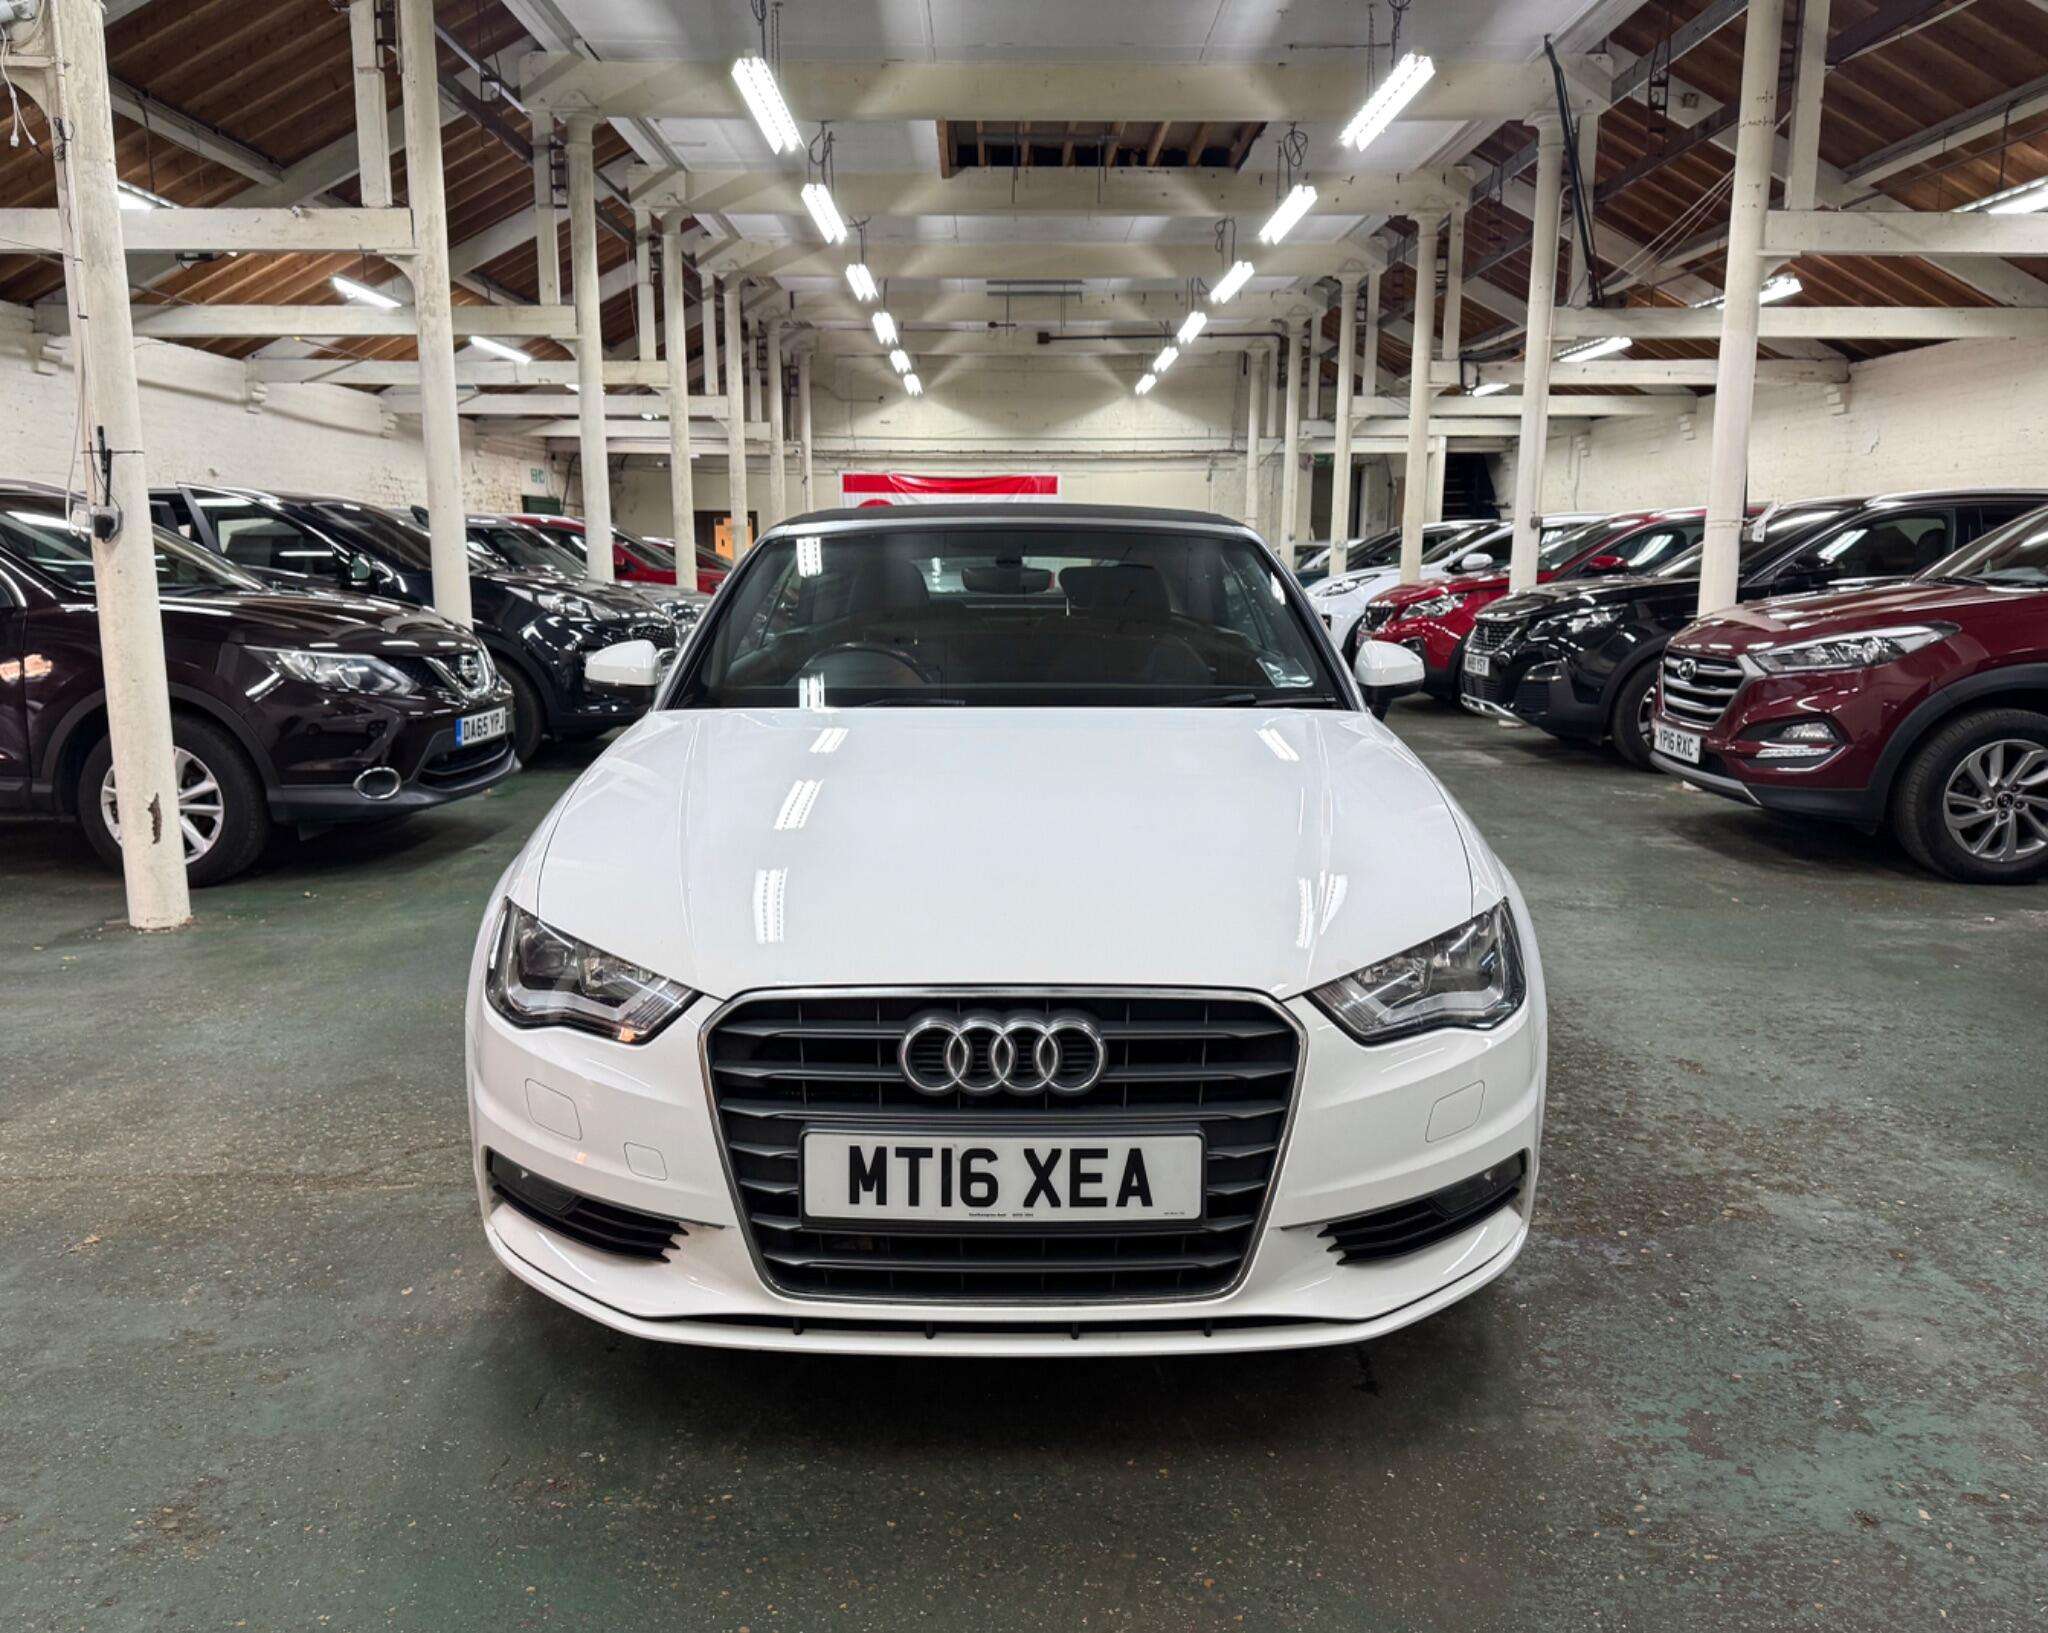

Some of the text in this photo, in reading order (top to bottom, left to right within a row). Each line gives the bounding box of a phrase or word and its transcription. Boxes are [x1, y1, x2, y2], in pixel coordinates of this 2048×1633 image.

[464, 710, 505, 740] DA65 YPJ
[1658, 728, 1694, 757] YP16 RXC
[848, 1145, 1153, 1208] MT16 XEA
